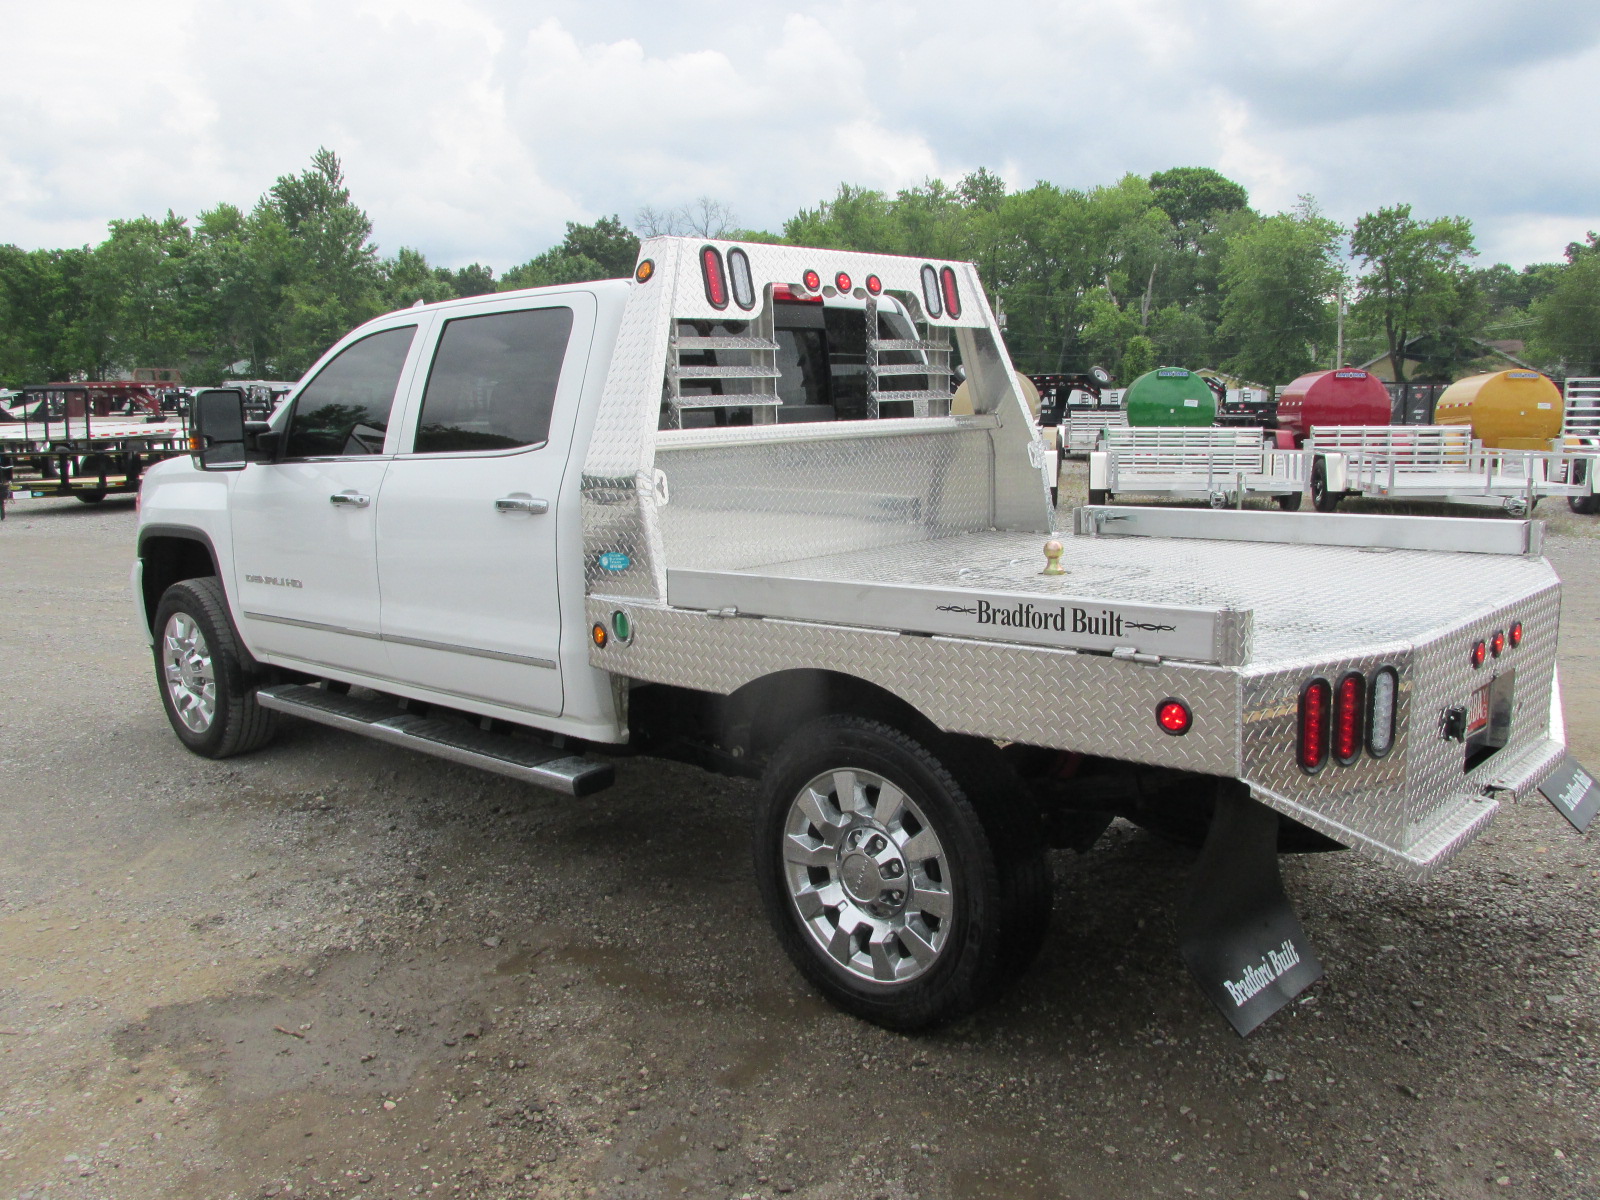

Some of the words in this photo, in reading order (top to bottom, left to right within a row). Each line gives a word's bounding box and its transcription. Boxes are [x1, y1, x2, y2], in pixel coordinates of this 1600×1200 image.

[976, 599, 1066, 632] Bradford
[1071, 607, 1124, 637] Built
[1223, 955, 1276, 1007] Bradford
[1267, 938, 1300, 977] Built
